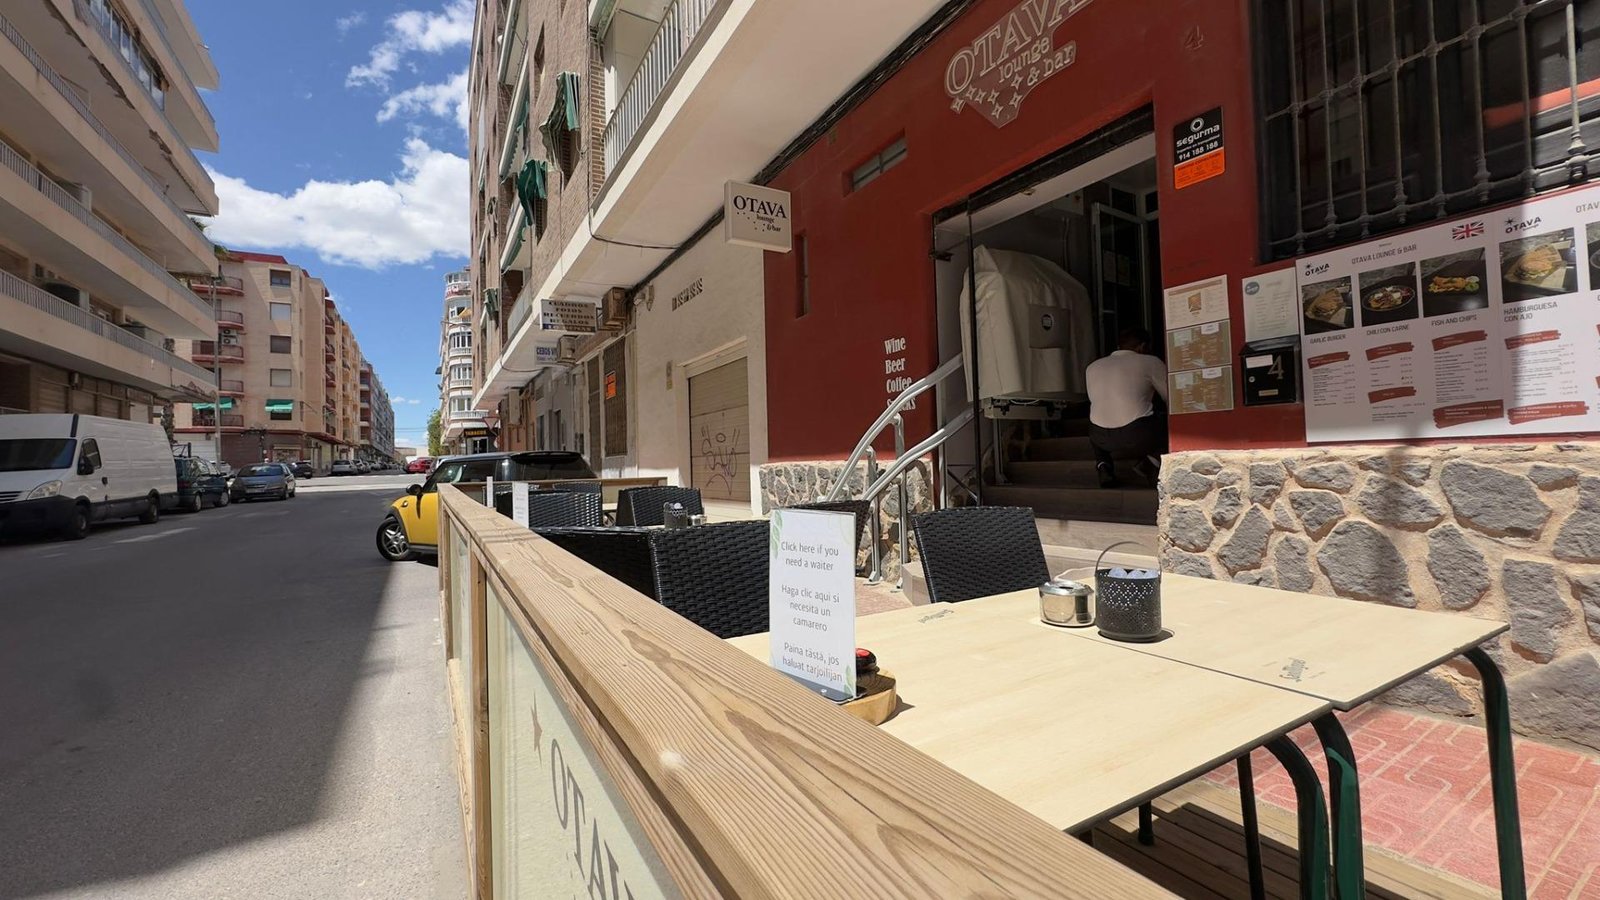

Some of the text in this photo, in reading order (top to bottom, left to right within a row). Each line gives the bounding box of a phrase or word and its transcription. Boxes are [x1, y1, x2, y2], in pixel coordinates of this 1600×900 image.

[999, 36, 1050, 83] lounge
[1027, 44, 1074, 86] & bar
[1176, 124, 1220, 147] segurma
[733, 195, 787, 219] OTAVA
[1505, 216, 1542, 234] OTAVA
[1351, 255, 1373, 264] OTAVA
[1403, 244, 1417, 253] BAR
[1305, 263, 1330, 276] OTAVA
[1503, 301, 1558, 315] HAMBURGUESA
[1503, 312, 1533, 322] CON AJO
[884, 337, 906, 354] Wine
[885, 358, 906, 374] Beer
[1267, 354, 1285, 380] 4
[886, 377, 912, 393] Coffee
[781, 541, 839, 557] Click here if you
[786, 558, 802, 567] need
[810, 561, 833, 570] waiter
[781, 584, 799, 598] Haga
[801, 587, 812, 598] clic
[790, 602, 831, 616] necesita un
[793, 617, 828, 631] camarero
[784, 642, 840, 666] Paina tästä, jos
[782, 656, 843, 682] haluat tarjoilijan
